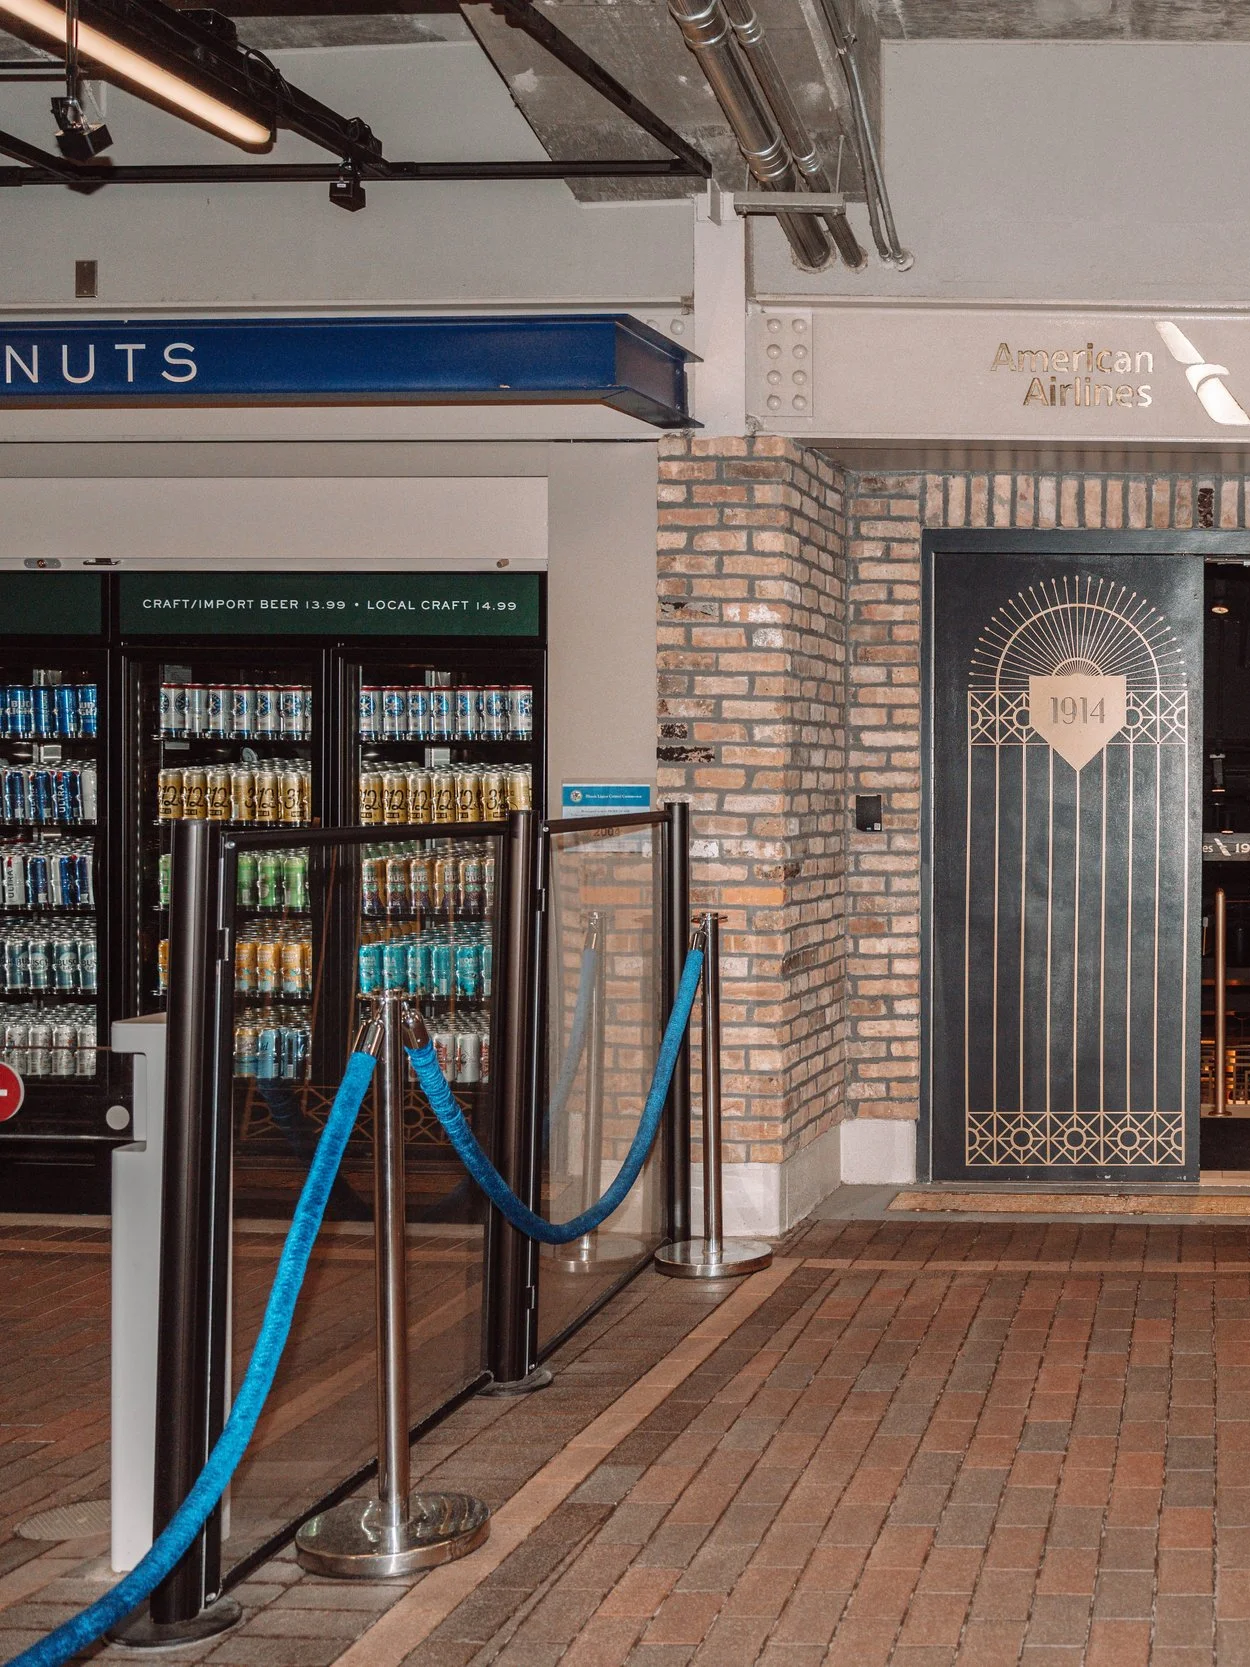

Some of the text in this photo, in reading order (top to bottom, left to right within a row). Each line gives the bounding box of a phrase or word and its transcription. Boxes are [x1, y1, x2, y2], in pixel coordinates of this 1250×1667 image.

[5, 342, 198, 384] NUTS
[990, 342, 1154, 374] American
[1022, 376, 1154, 408] Airlines
[142, 598, 517, 611] CRAFT/IMPORT BEER 13.99 LOCAL CRAFT 14.99
[1050, 696, 1106, 725] 1914
[58, 783, 66, 813] ULTRA
[7, 869, 15, 899] ULTRA
